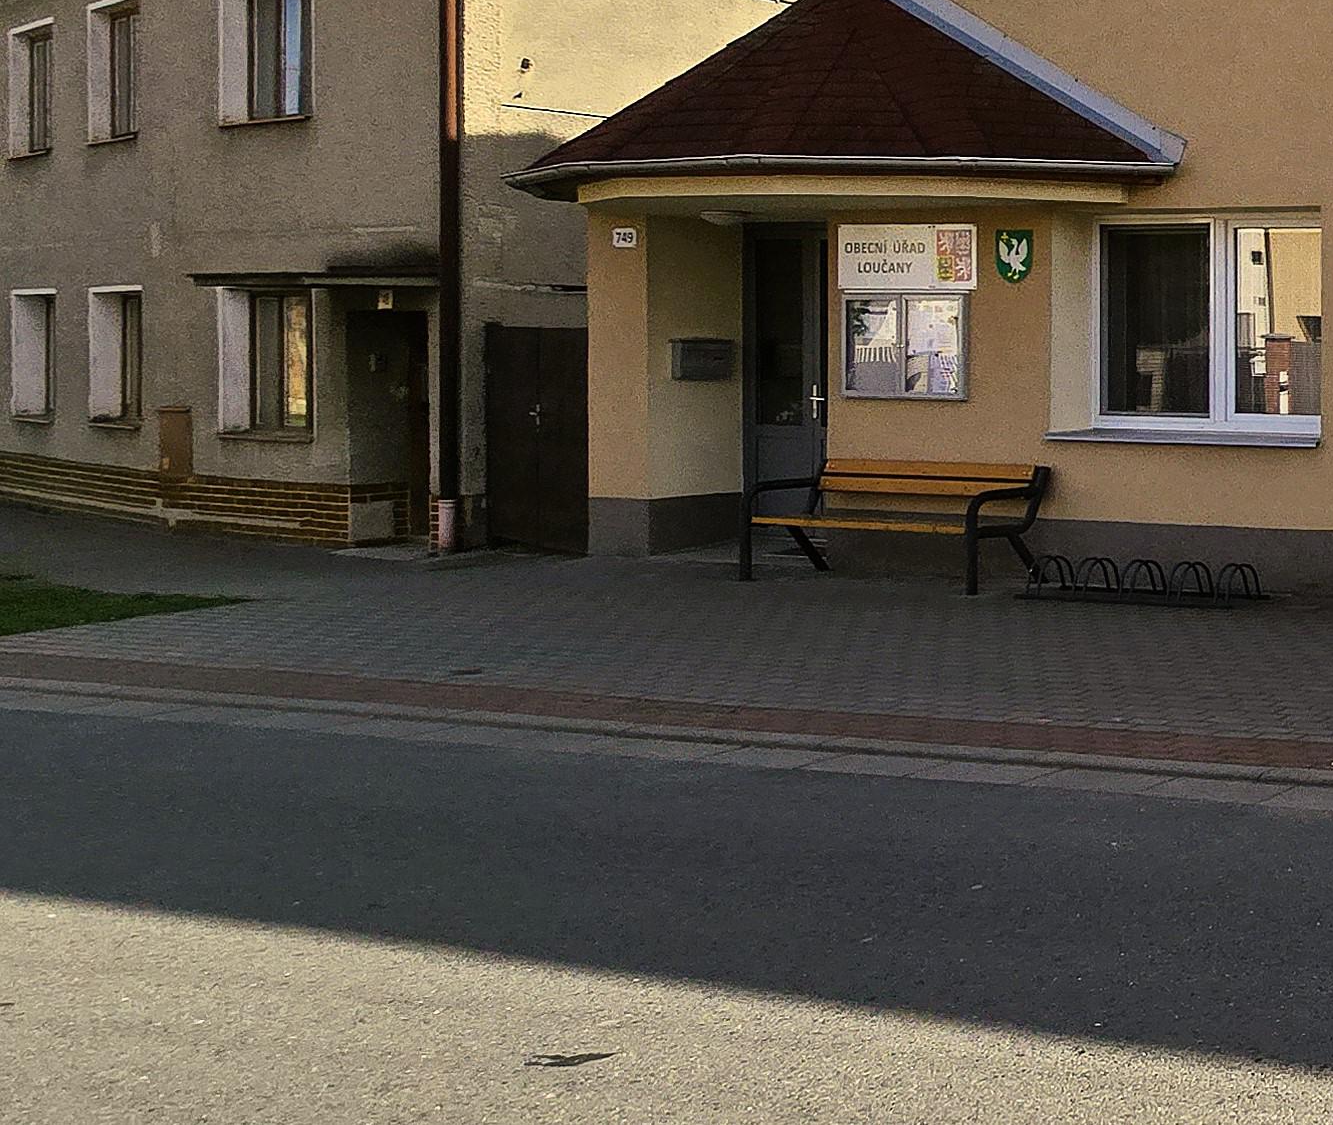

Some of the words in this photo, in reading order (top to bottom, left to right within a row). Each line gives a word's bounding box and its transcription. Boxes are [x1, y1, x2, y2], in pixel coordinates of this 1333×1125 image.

[615, 232, 634, 243] 749
[844, 239, 887, 254] OBECNÍ
[893, 239, 926, 254] ÚŘAD
[857, 259, 913, 274] LOUČANY
